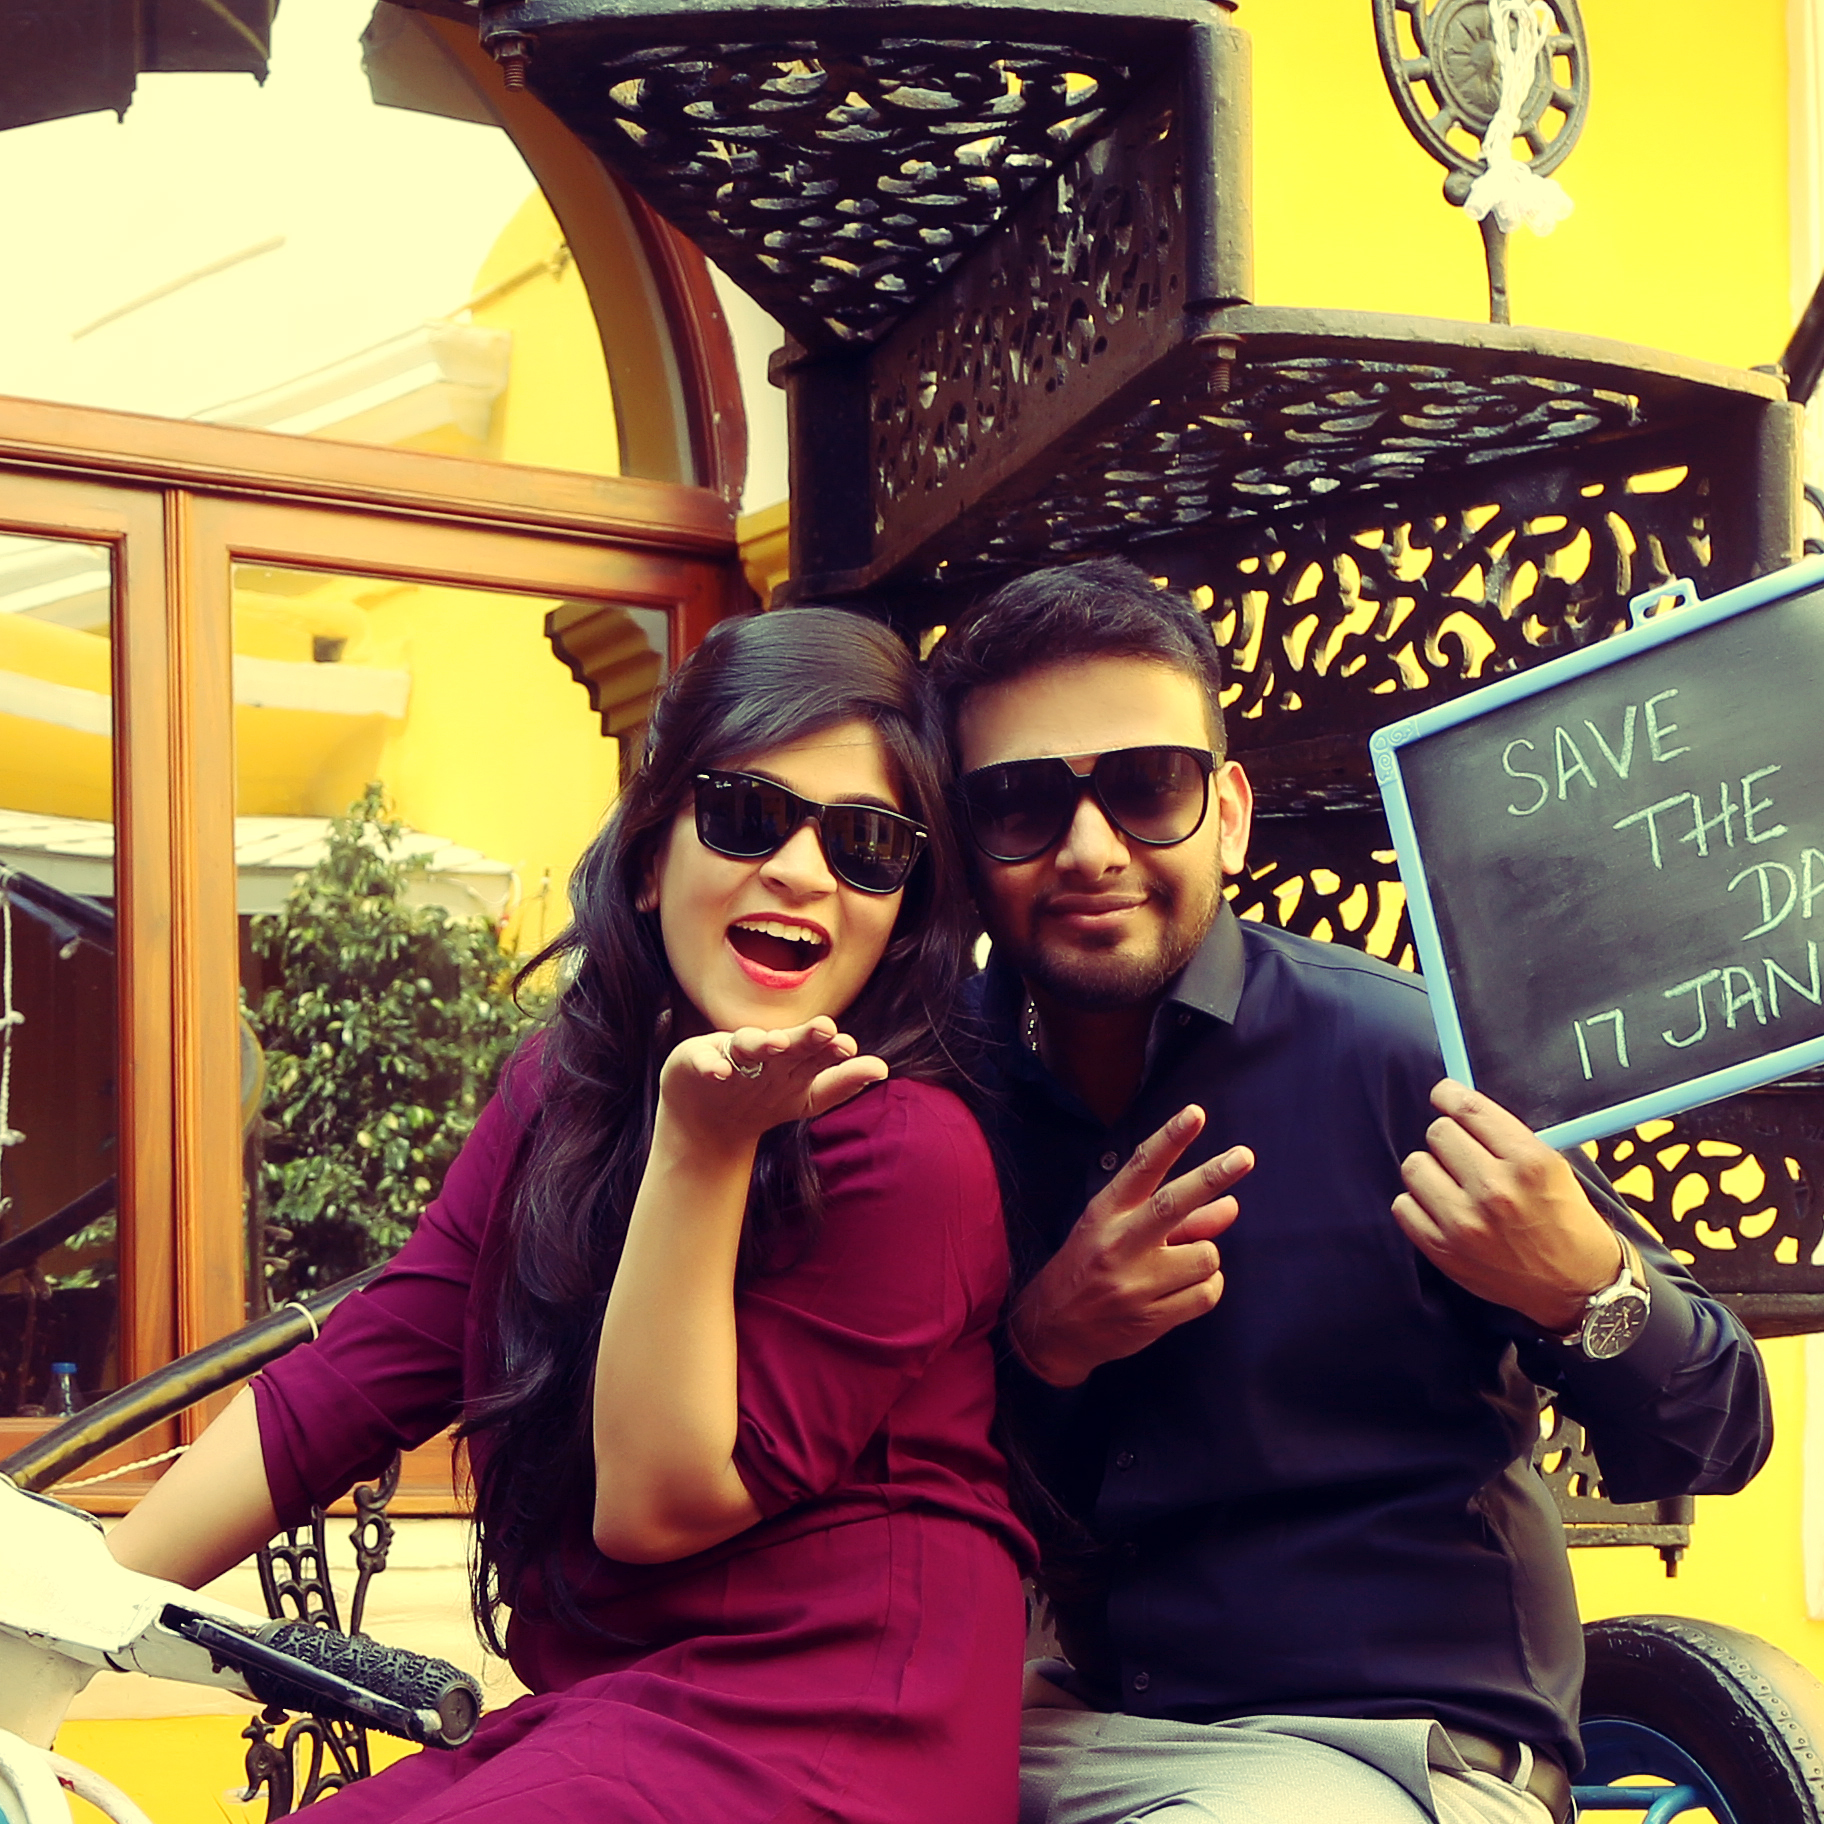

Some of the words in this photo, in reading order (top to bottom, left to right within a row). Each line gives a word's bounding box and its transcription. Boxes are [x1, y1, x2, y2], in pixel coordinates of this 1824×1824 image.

[1502, 688, 1692, 817] SAVE
[1612, 764, 1790, 870] THE
[1573, 1008, 1630, 1080] 17
[1661, 940, 1822, 1048] JAN
